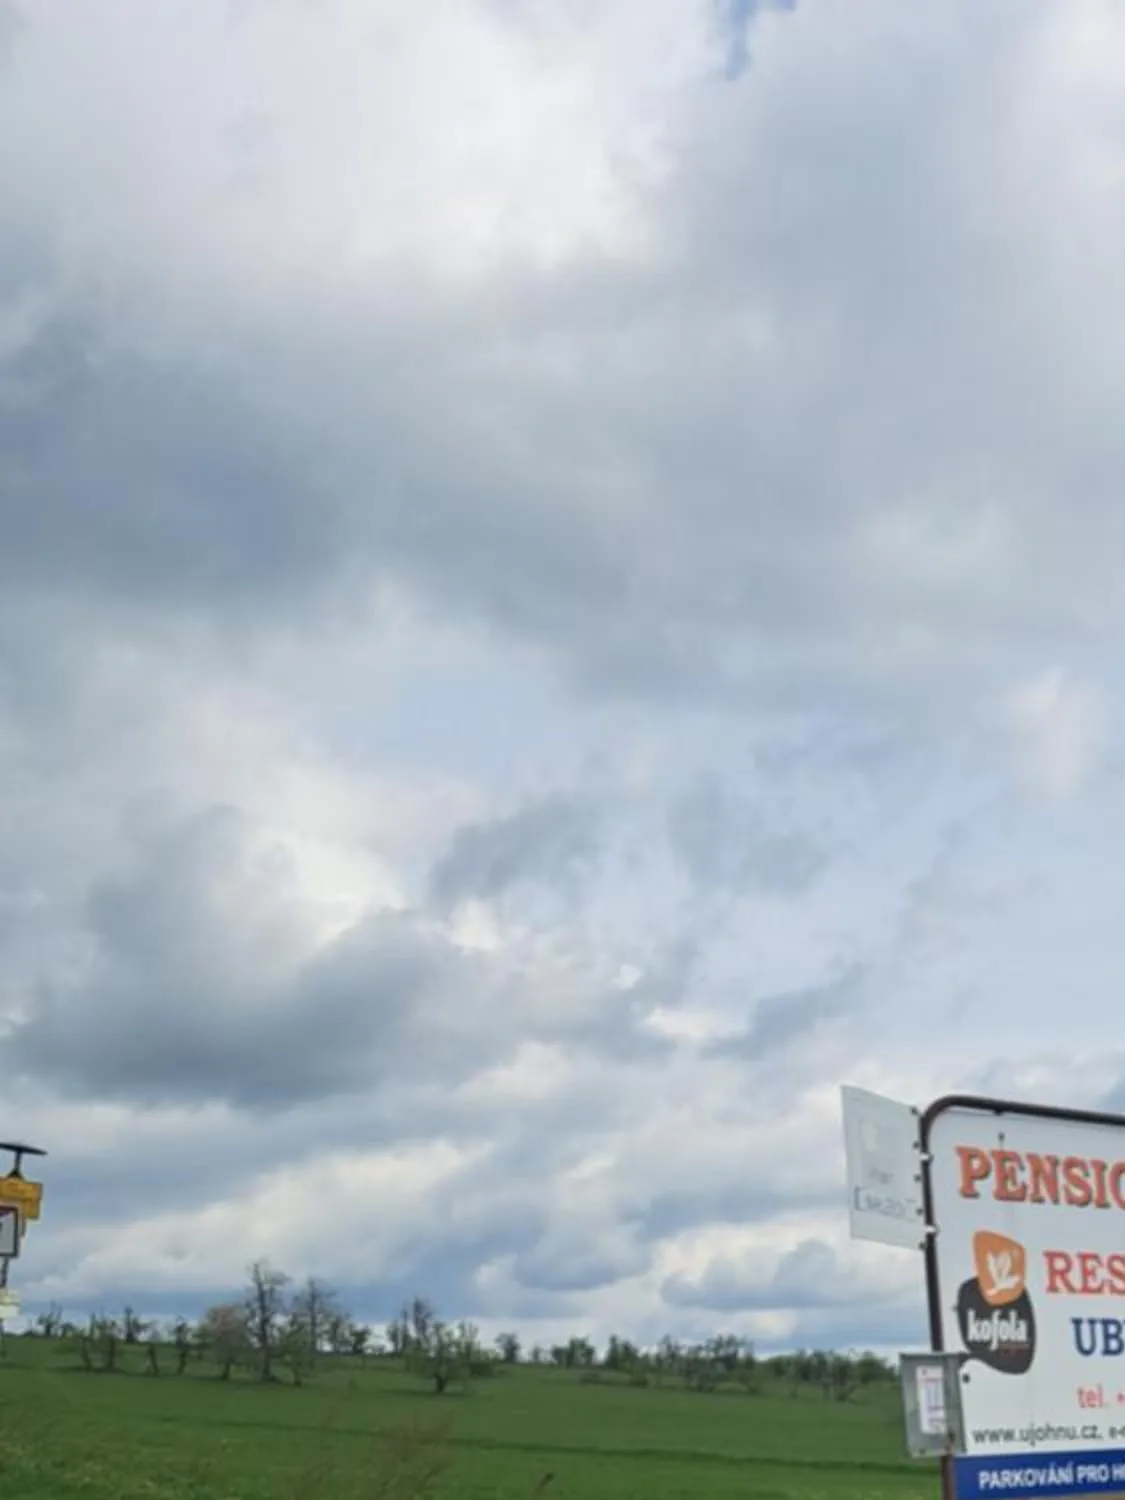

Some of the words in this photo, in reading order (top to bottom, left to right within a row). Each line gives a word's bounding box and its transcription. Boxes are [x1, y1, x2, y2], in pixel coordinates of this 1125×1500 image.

[967, 1308, 1028, 1351] kofola
[978, 1462, 1073, 1490] PARKOVÁNÍ
[1077, 1463, 1109, 1483] PRO
